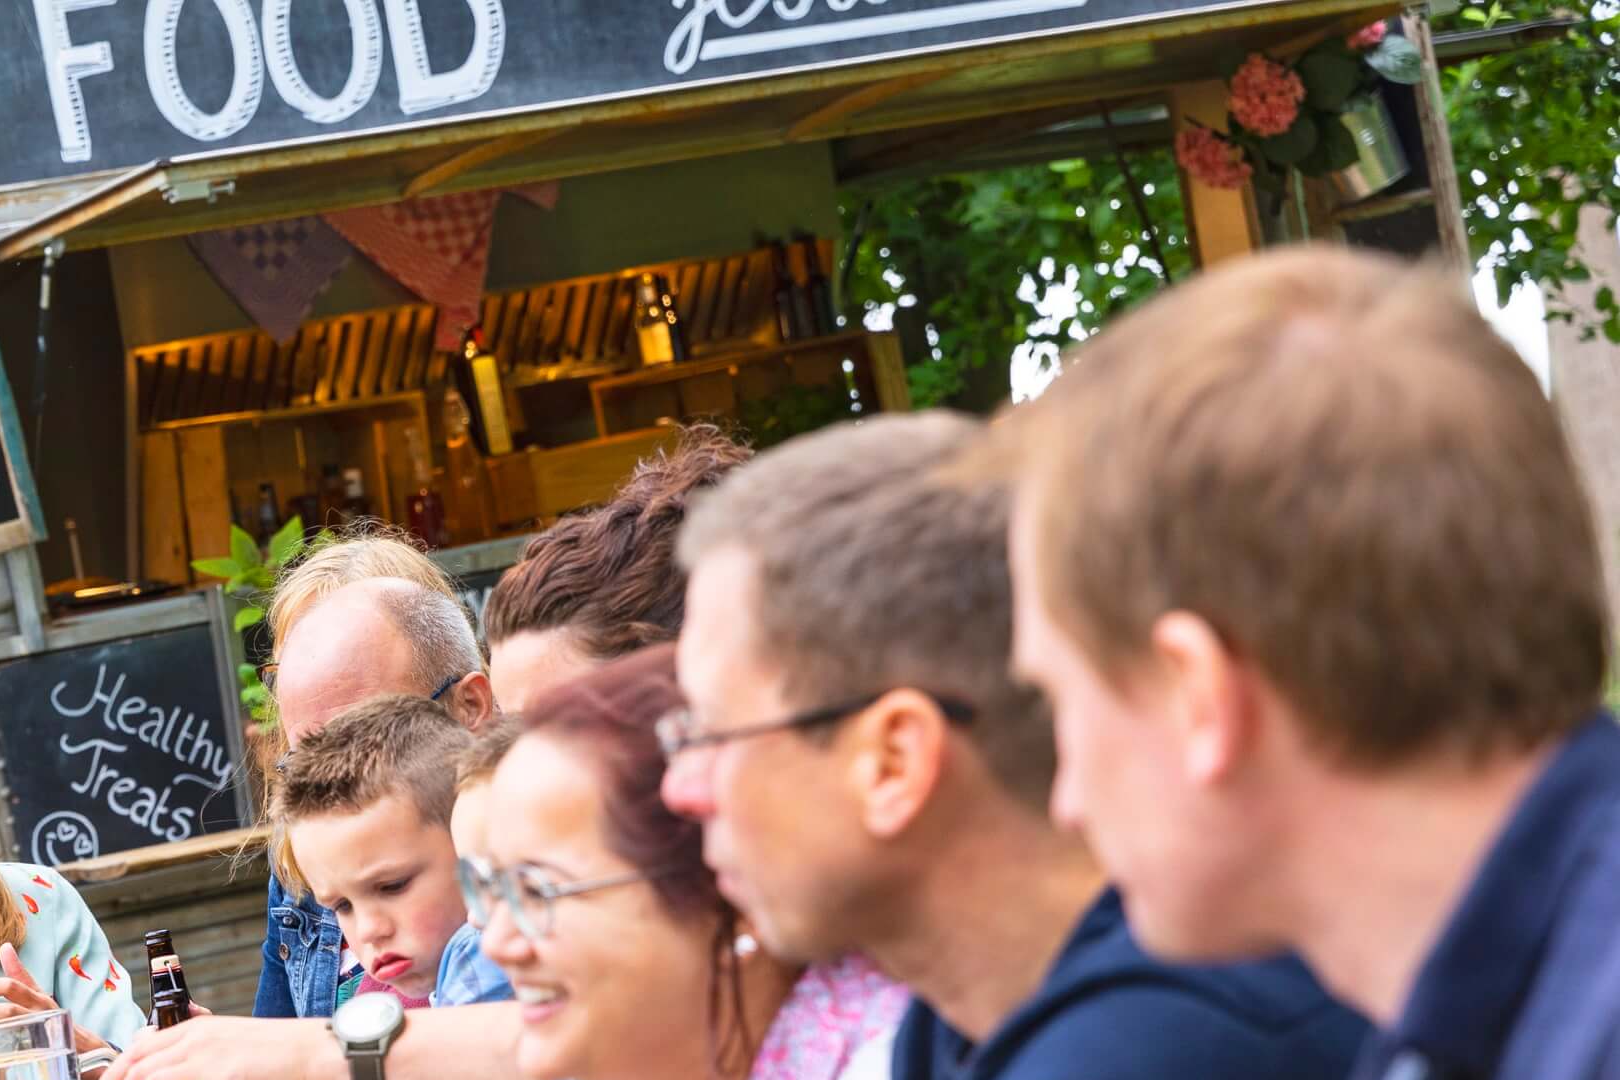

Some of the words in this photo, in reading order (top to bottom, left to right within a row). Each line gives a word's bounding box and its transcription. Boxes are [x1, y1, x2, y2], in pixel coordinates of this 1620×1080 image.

[33, 0, 506, 163] FOOD
[50, 663, 231, 790] Healthy
[59, 733, 195, 842] Treats
